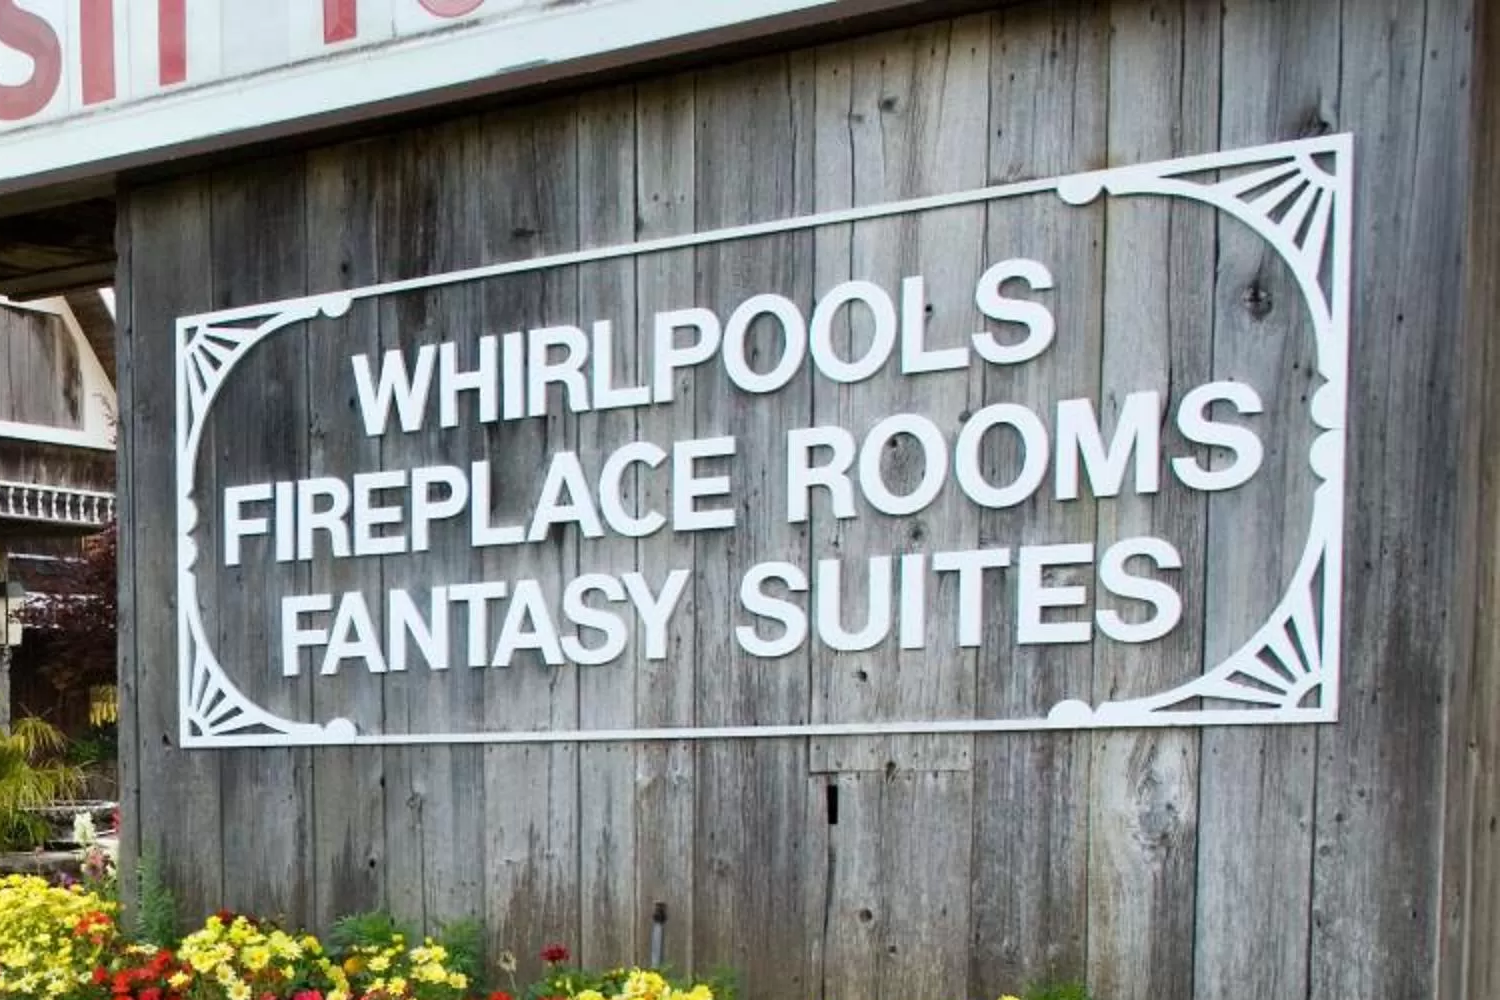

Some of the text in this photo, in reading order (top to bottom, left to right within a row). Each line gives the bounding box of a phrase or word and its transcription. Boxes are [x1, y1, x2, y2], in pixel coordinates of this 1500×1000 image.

[350, 257, 1056, 436] WHIRLPOOLS
[223, 380, 1264, 566] FIREPLACE ROOMS
[280, 535, 1182, 677] FANTASY SUITES
